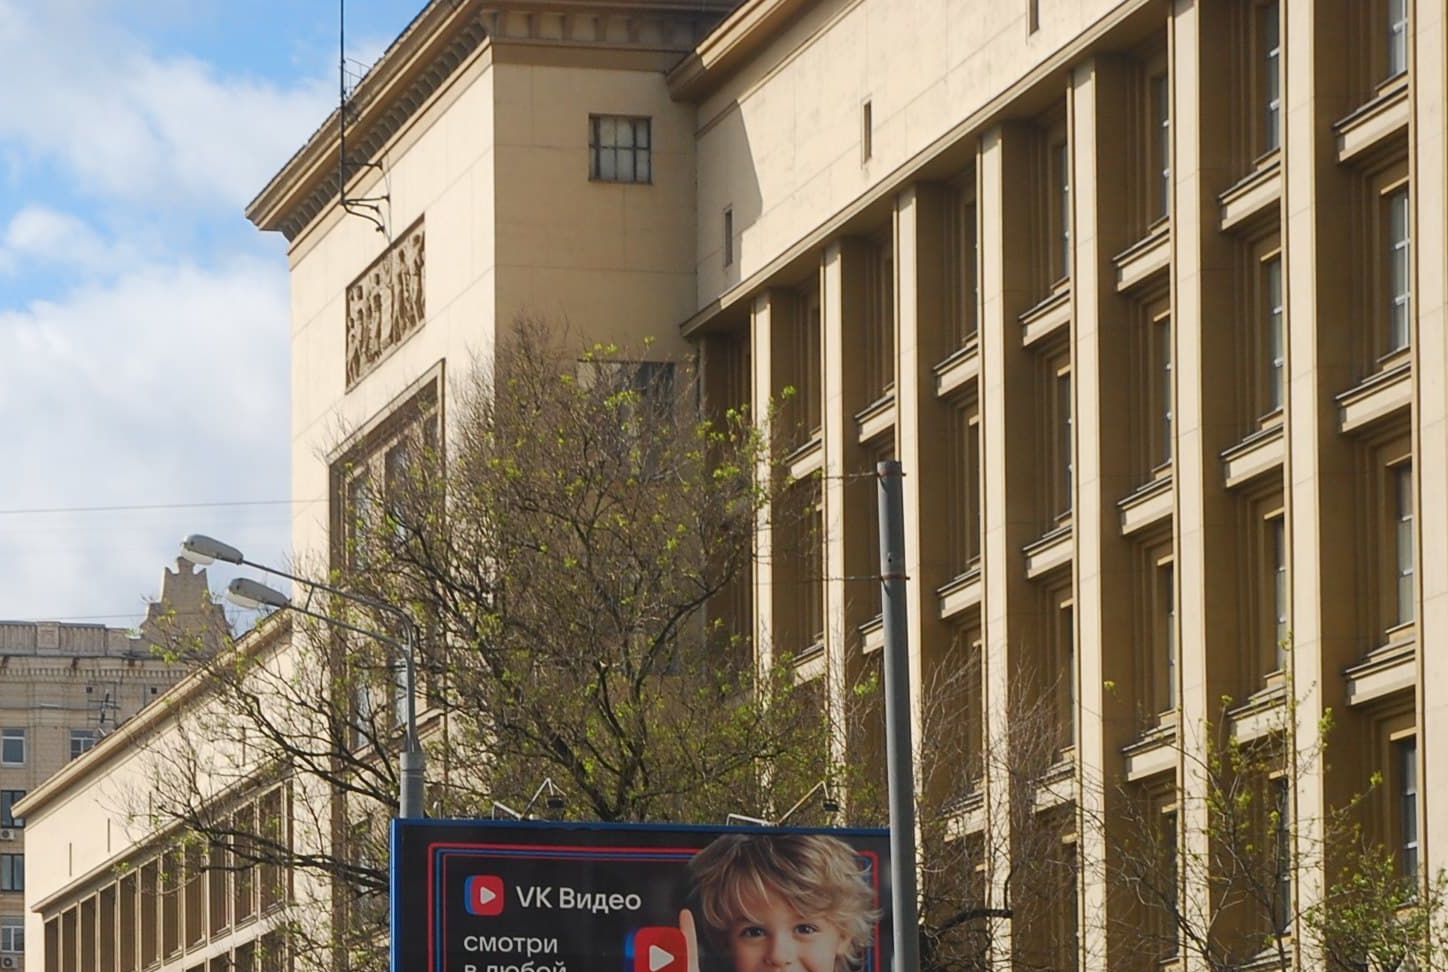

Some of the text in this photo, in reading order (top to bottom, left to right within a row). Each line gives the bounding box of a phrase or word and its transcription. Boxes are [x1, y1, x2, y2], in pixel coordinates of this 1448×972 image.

[515, 885, 642, 914] VK Видео
[463, 935, 558, 958] смотри
